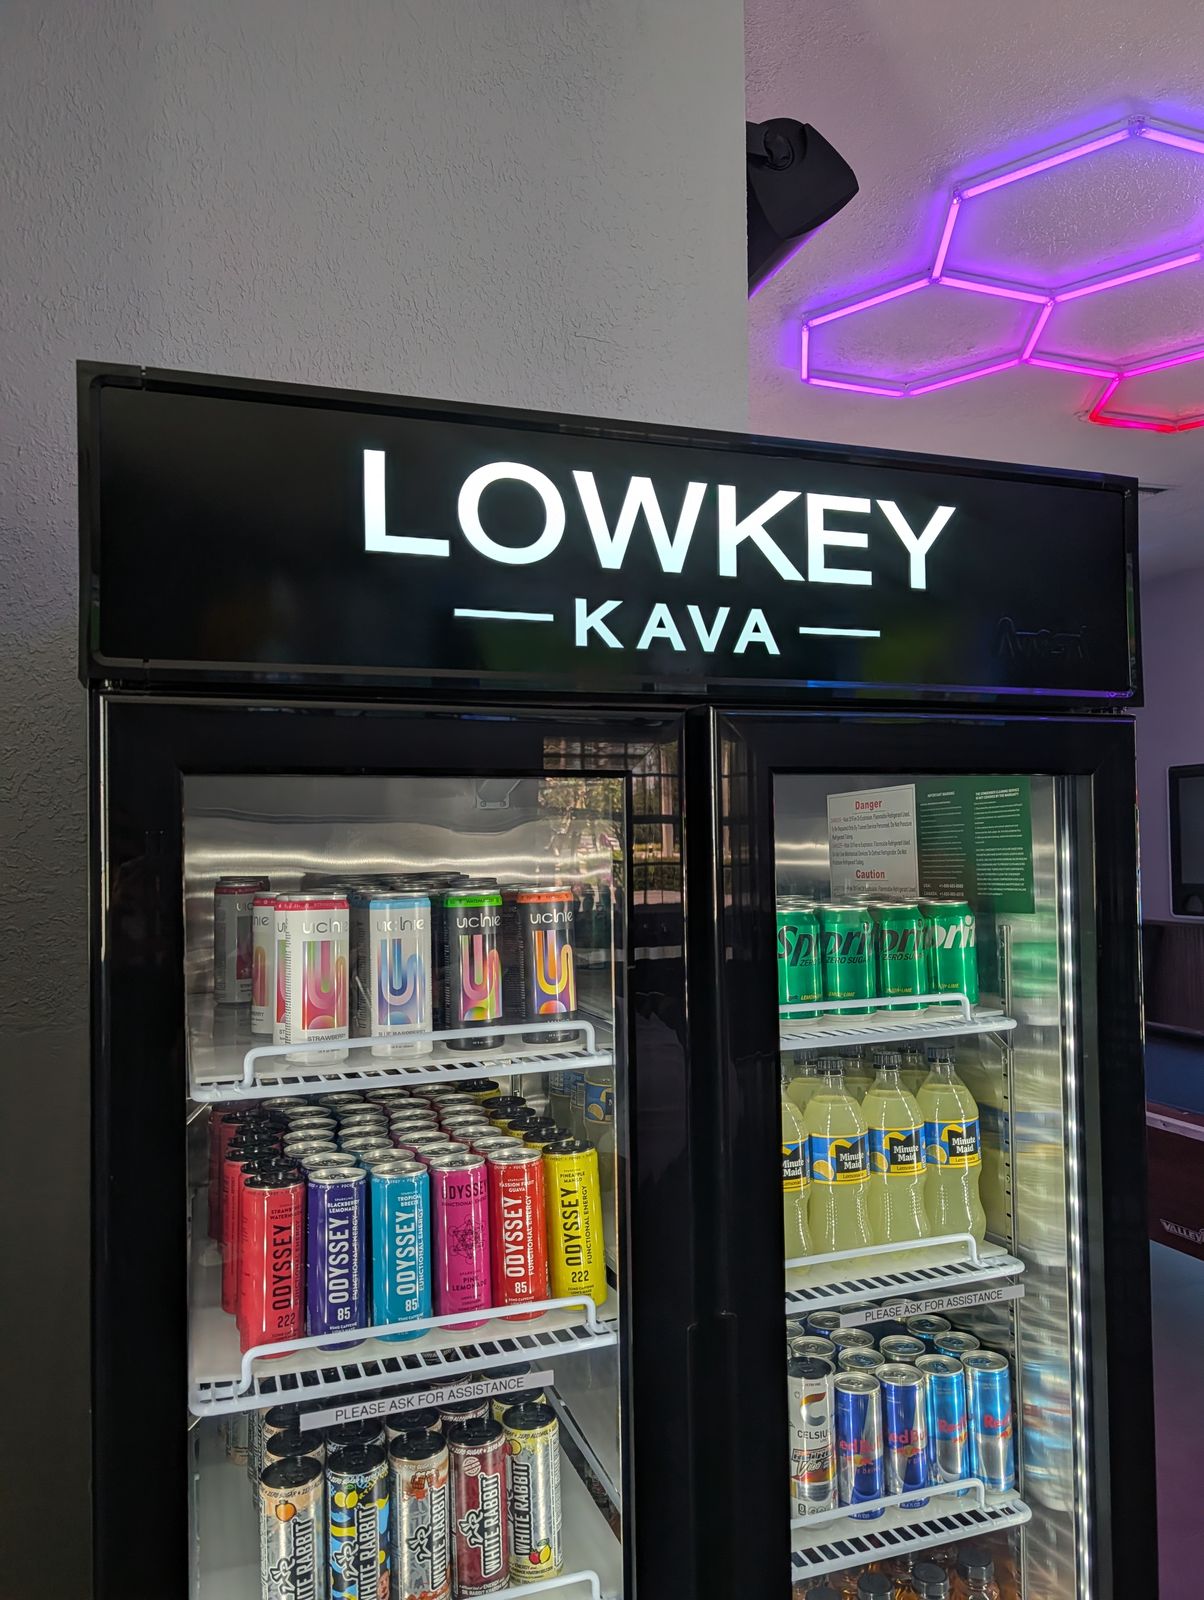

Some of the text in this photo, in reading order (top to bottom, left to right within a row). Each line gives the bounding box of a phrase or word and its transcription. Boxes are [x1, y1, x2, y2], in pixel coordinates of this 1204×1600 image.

[363, 449, 956, 589] LOWKEY
[575, 598, 781, 656] KAVA
[855, 800, 883, 811] Danger
[856, 869, 885, 879] Caution
[839, 1151, 864, 1162] Minute
[893, 1144, 919, 1155] Minute
[897, 1152, 916, 1162] Maid
[951, 1136, 976, 1146] Minute
[956, 1144, 974, 1153] Maid
[783, 1166, 801, 1177] Maid
[844, 1160, 862, 1170] Maid
[503, 1196, 526, 1278] ODYSSEY
[560, 1187, 584, 1267] ODYSSEY
[581, 1185, 593, 1264] FUNCTIONAL ENERGY
[272, 1224, 292, 1311] ODYSSEY
[328, 1217, 349, 1304] ODYSSEY
[395, 1211, 416, 1296] ODYSSEY
[514, 1281, 527, 1294] 85
[571, 1270, 589, 1283] 222
[277, 1312, 296, 1328] 222
[337, 1307, 350, 1321] 85
[405, 1298, 418, 1312] 85
[864, 1290, 1003, 1322] PLEASE ASK FOR ASSISTANCE
[335, 1377, 525, 1421] PLEASE ASK FOR ASSISTANCE
[483, 1476, 500, 1575] WHITE RABBIT
[513, 1464, 531, 1555] WHITE RABBIT
[295, 1518, 314, 1572] RABBIT
[359, 1505, 377, 1561] RABBIT
[433, 1488, 446, 1587] WHITE RABBIT
